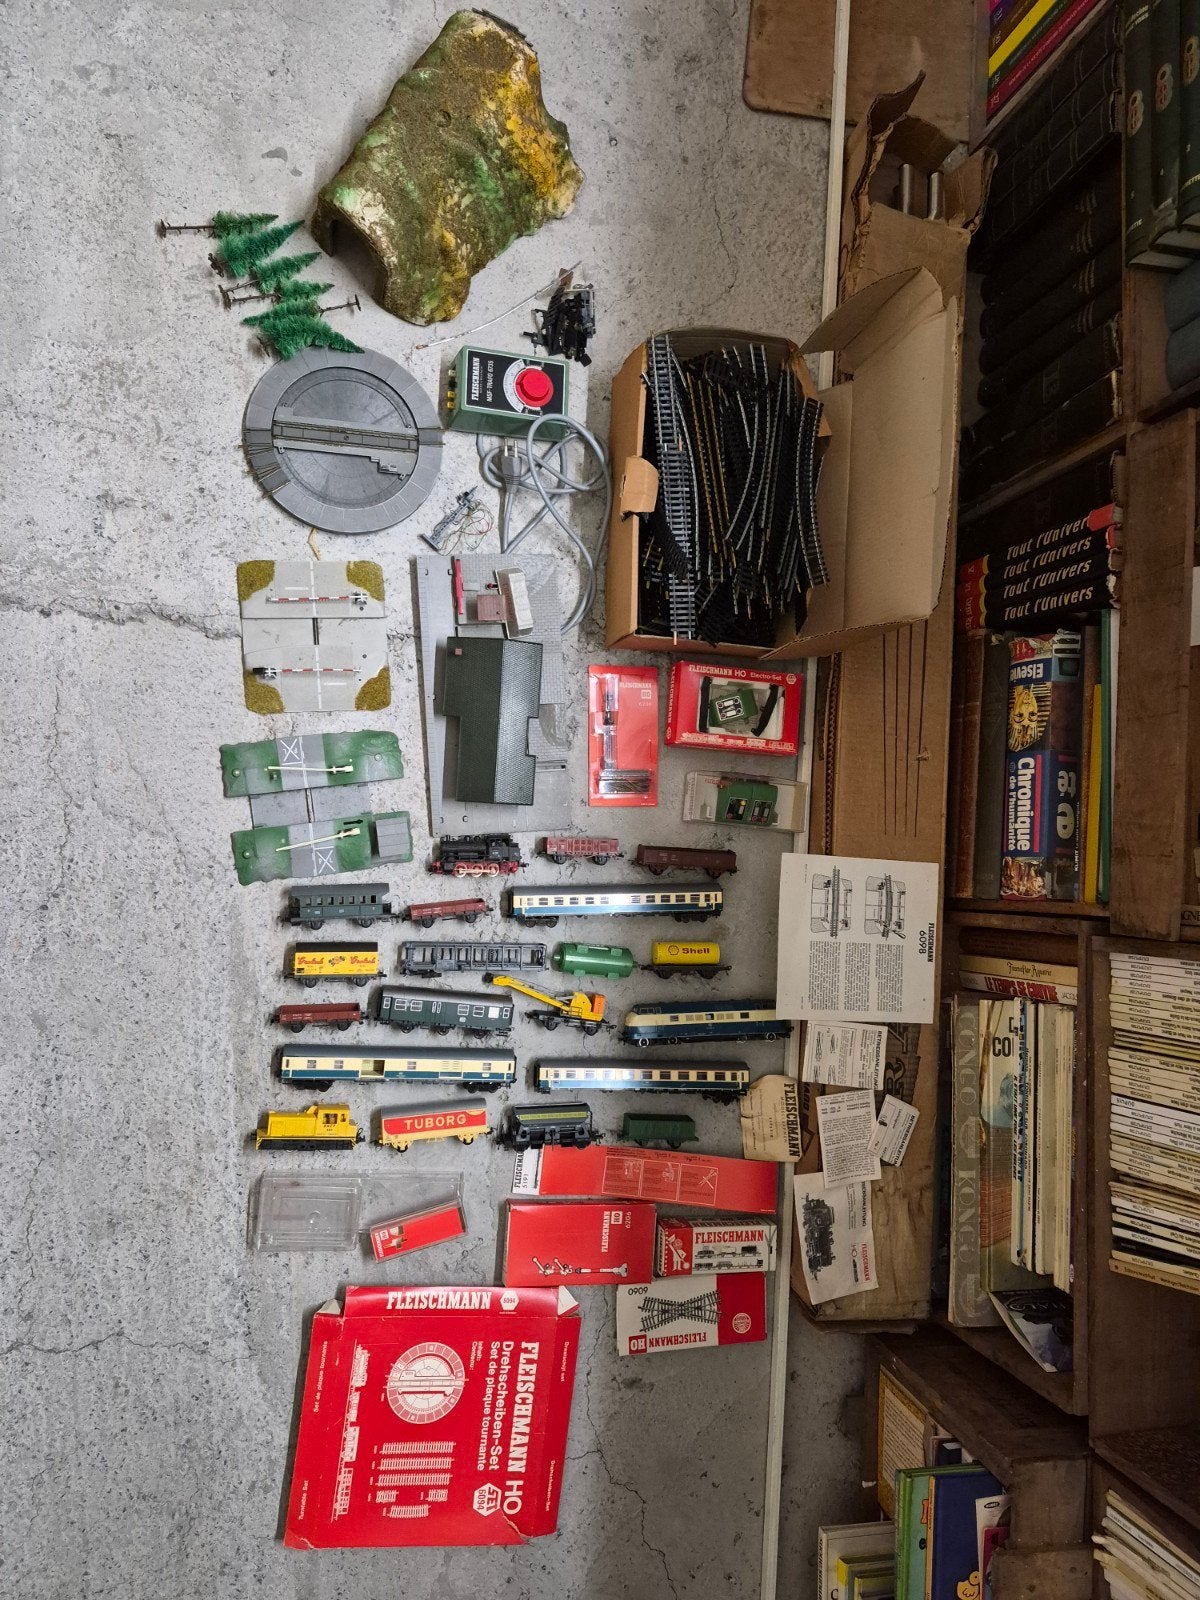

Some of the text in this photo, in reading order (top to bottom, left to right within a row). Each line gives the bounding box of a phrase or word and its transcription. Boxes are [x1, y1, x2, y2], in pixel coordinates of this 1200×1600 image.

[471, 356, 480, 400] FLEISCHMANN
[1003, 536, 1092, 580] Tout l'Univers
[1007, 517, 1089, 560] Tout l'Univer
[1003, 559, 1092, 599] Tout l'Univers
[1004, 585, 1094, 621] Tout l'Univers
[688, 664, 782, 682] FLEISCHMANN HO Electro-Set
[1007, 776, 1017, 851] de l'humanité
[1015, 756, 1035, 852] Chronique
[682, 946, 710, 955] Shell
[918, 930, 927, 954] 6098
[926, 922, 935, 963] FLEISCHMANN
[957, 1011, 978, 1106] CONGO
[992, 1036, 1014, 1057] CO
[404, 1114, 467, 1130] TUBORG
[784, 1083, 800, 1158] FLEISCHMANN
[1116, 1098, 1135, 1107] DUPUIS
[514, 1152, 524, 1189] FLEISCHMA
[602, 1212, 612, 1253] FLEISCHMANN
[613, 1212, 621, 1224] HO
[957, 1169, 978, 1264] KONGO
[694, 1230, 764, 1244] FLEISCHMANN
[861, 1243, 870, 1282] FLEISCHMANN
[386, 1290, 492, 1310] FLEISCHMANN
[469, 1341, 478, 1371] Contenu:
[630, 1332, 708, 1351] HO FLEISCHMANN
[476, 1341, 501, 1471] Set de plaque tournante
[488, 1341, 514, 1471] Drehscheiben-Set
[502, 1341, 540, 1516] FLEISCHMANN HO
[476, 1488, 490, 1510] 6094
